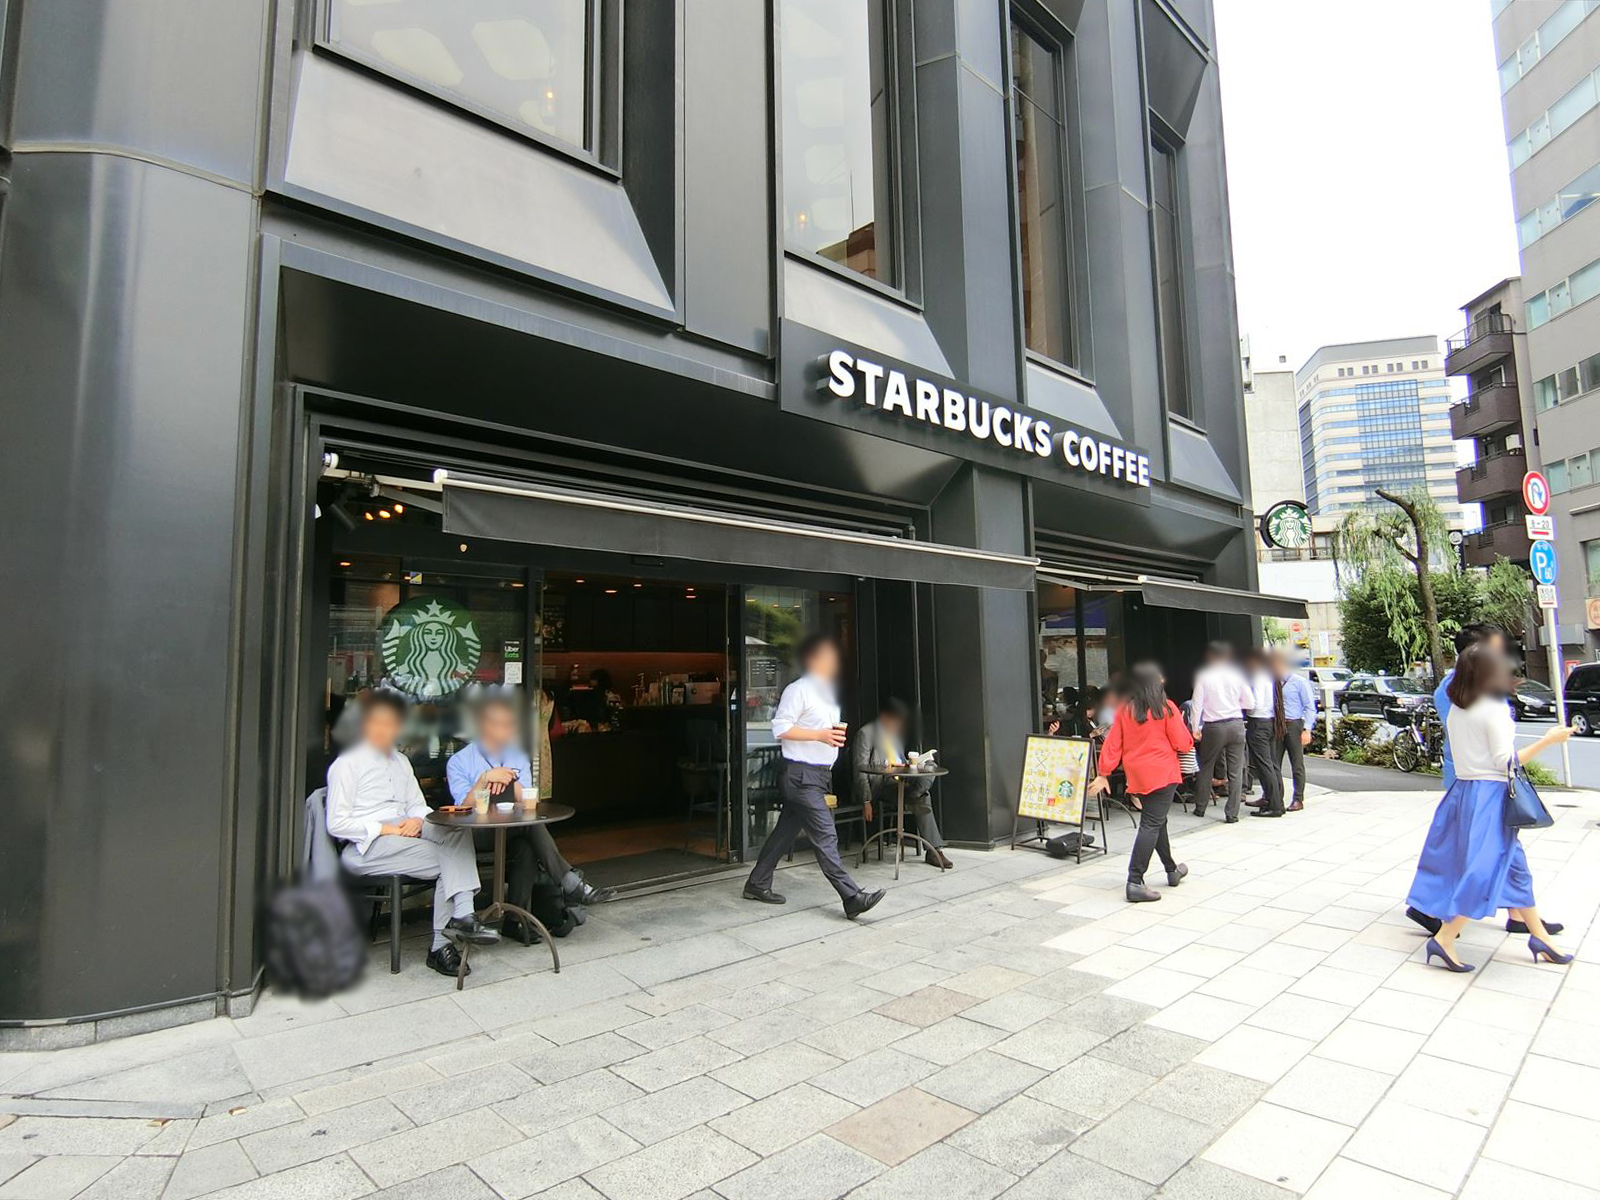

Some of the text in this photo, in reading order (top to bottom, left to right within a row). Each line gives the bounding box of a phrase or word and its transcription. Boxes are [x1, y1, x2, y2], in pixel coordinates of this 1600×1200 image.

[828, 350, 1150, 488] STARBUCKS COFFEE
[1535, 552, 1547, 580] P
[504, 645, 520, 653] Uber
